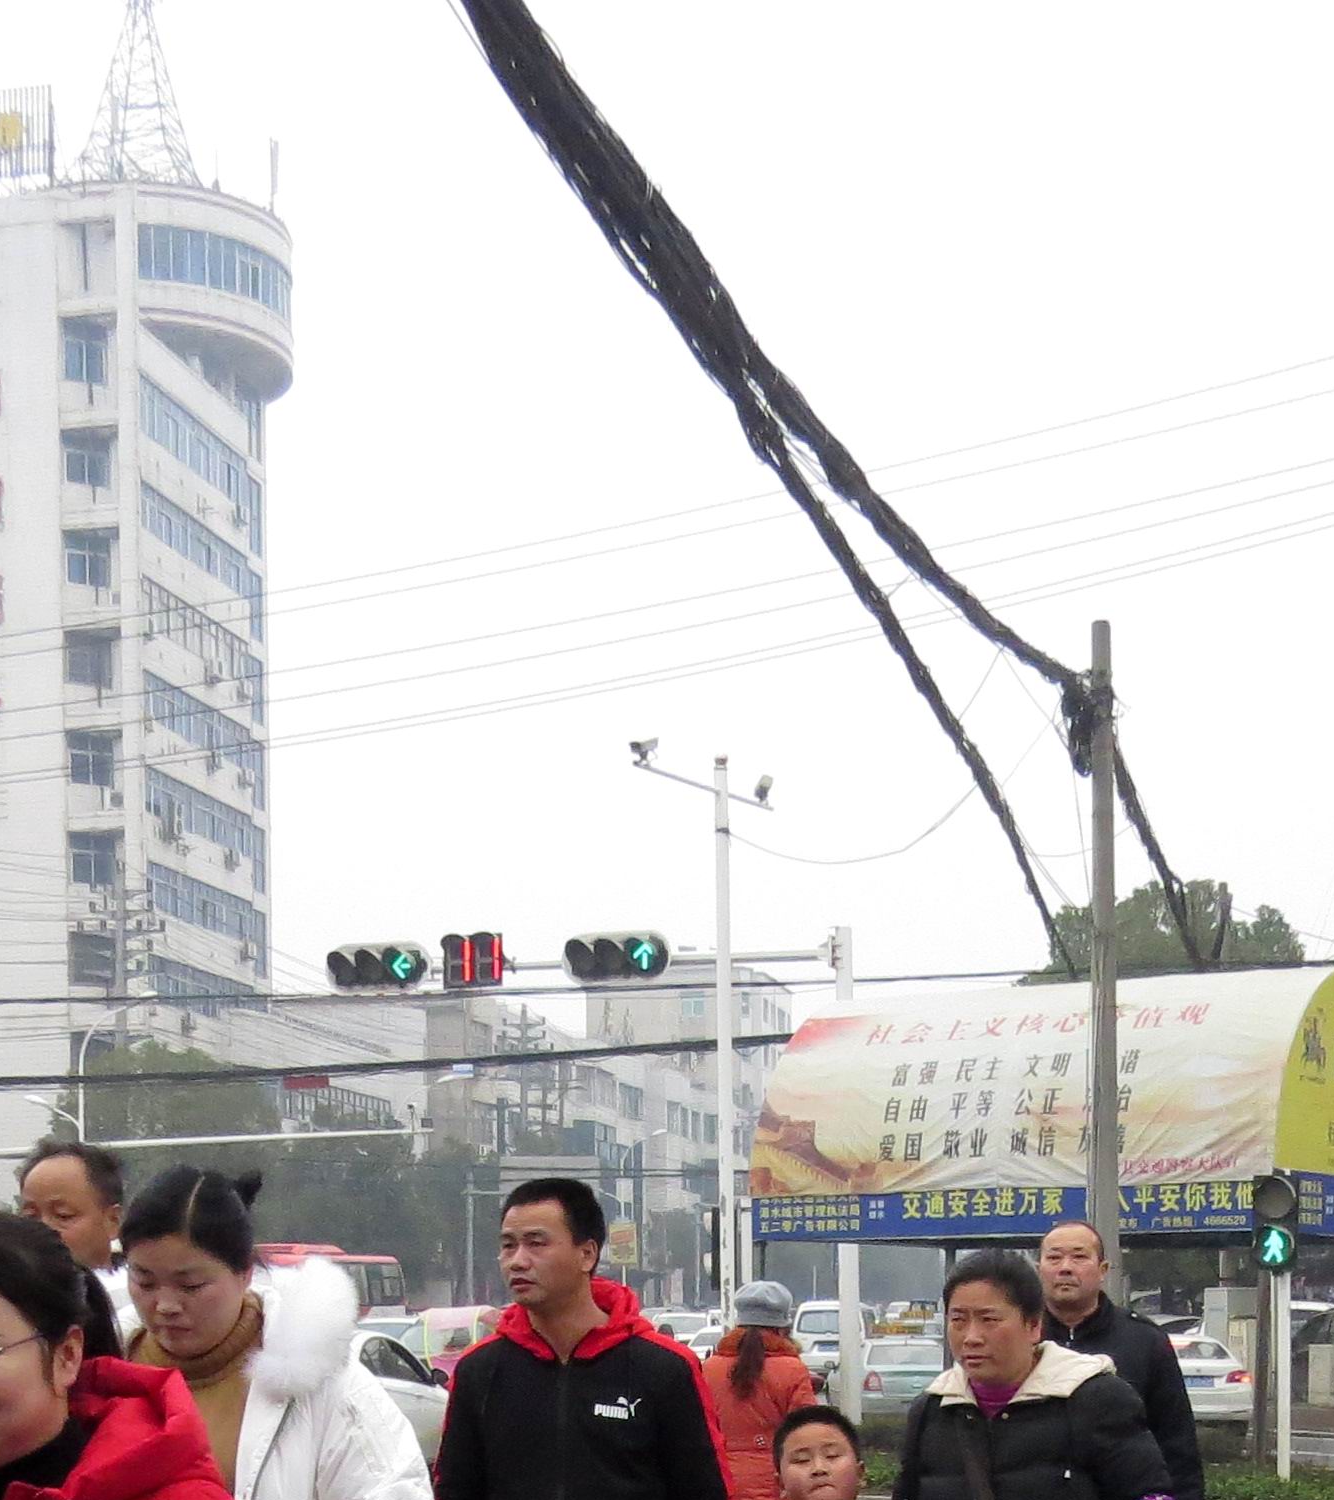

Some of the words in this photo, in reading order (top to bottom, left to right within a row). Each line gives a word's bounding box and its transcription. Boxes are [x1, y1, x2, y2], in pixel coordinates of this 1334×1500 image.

[865, 1003, 1210, 1046] 社会主义核心值观
[891, 1060, 939, 1087] 富强
[955, 1057, 1004, 1082] 民主
[1023, 1052, 1072, 1078] 文明
[884, 1095, 929, 1124] 自由
[949, 1089, 995, 1120] 平等
[1015, 1088, 1063, 1116] 公正
[878, 1132, 923, 1163] 爱国
[943, 1127, 988, 1159] 敬业
[1010, 1126, 1057, 1156] 诚信
[902, 1188, 1064, 1220] 交通安全进万家
[593, 1402, 629, 1420] PUMA
